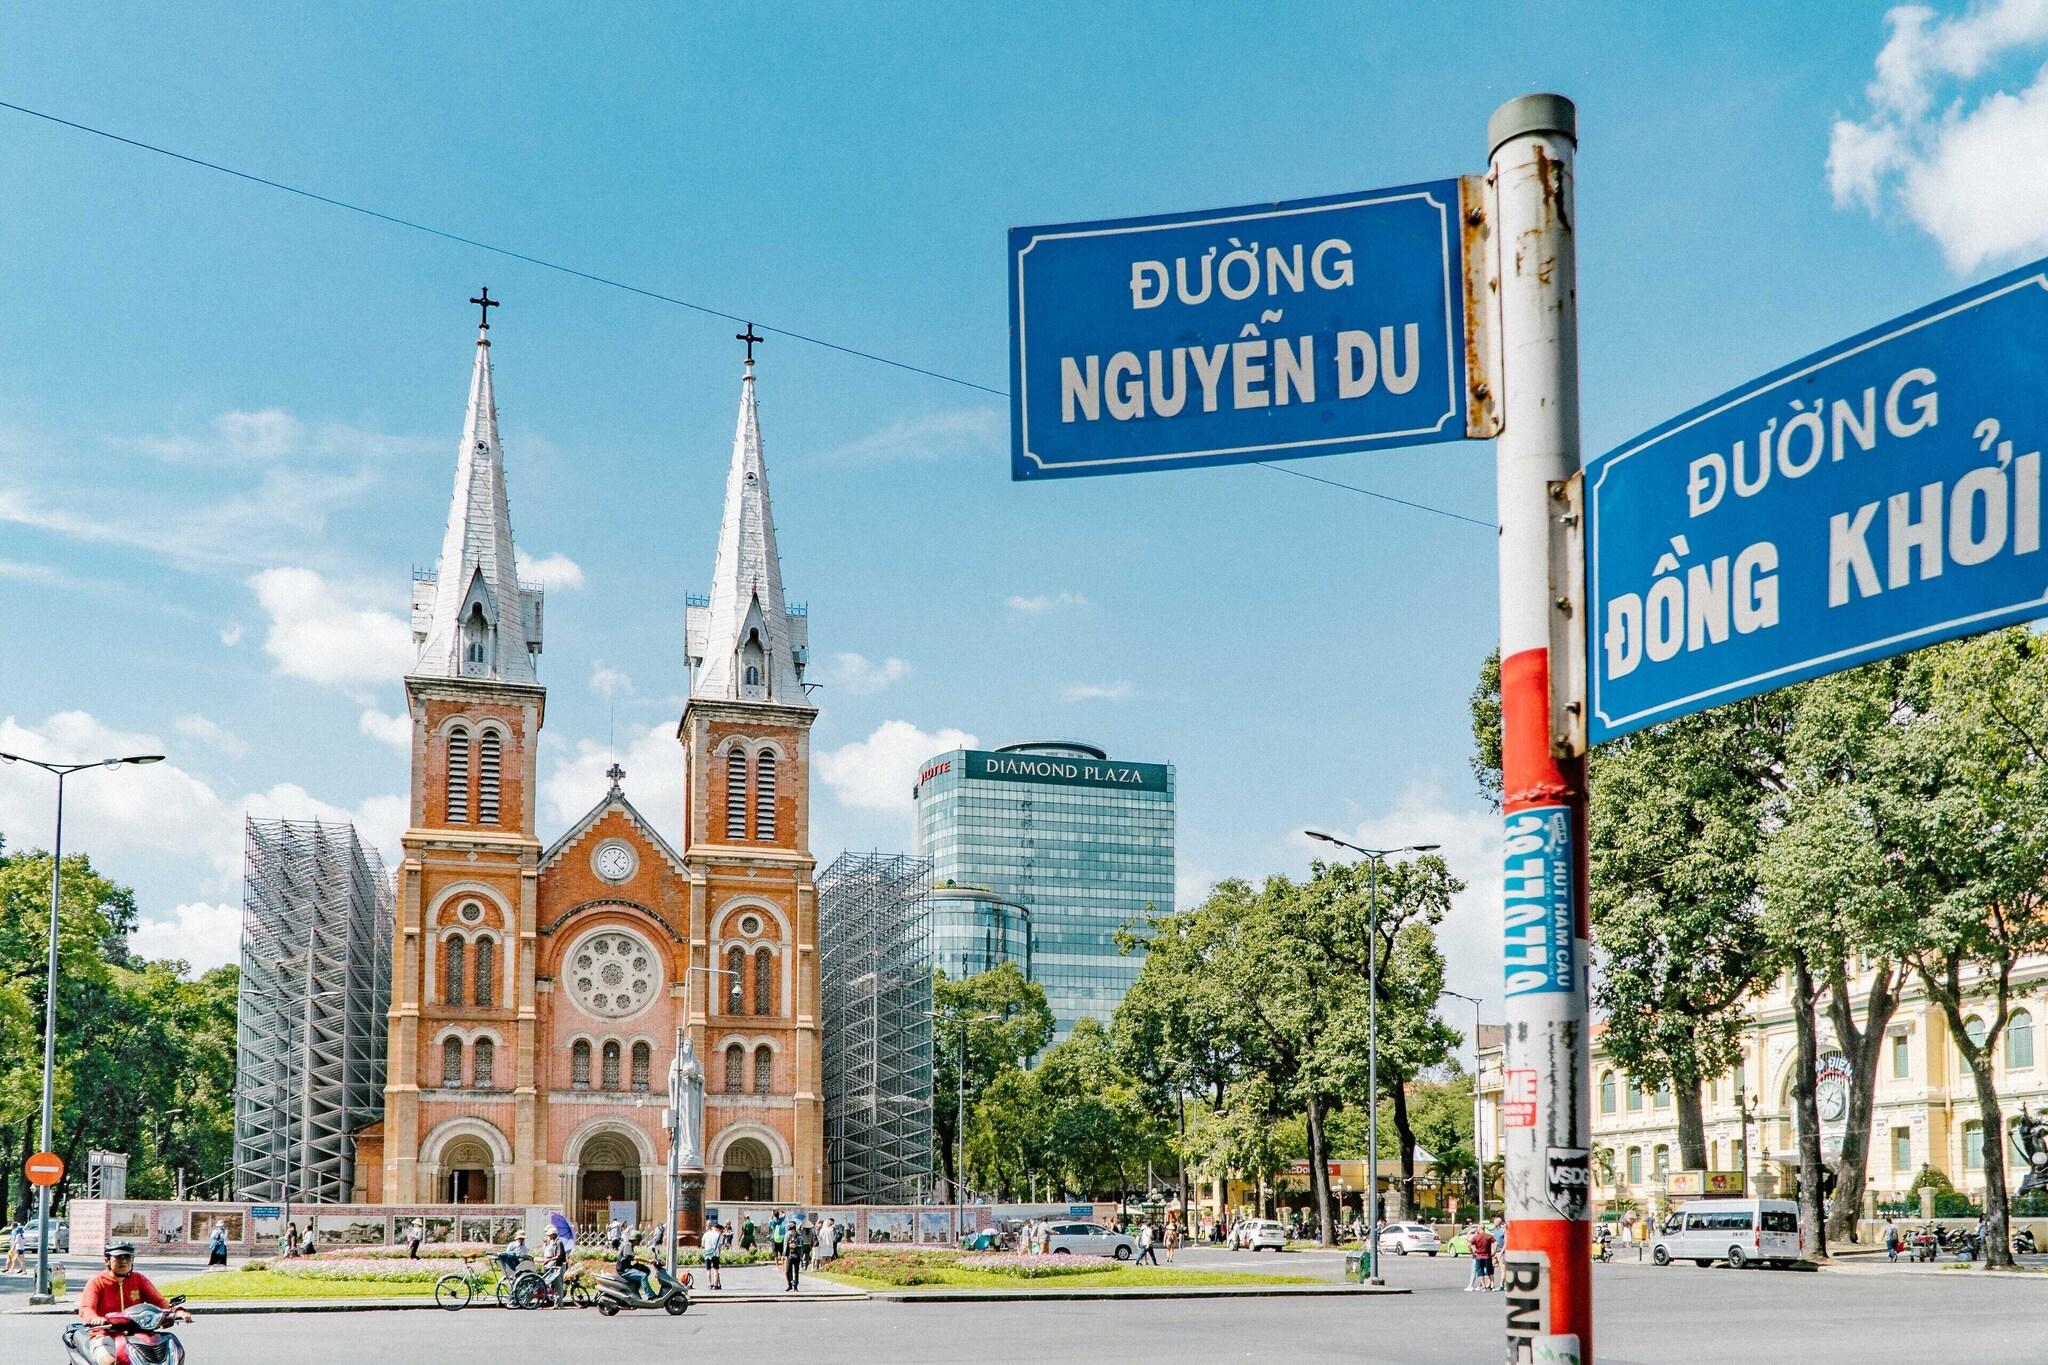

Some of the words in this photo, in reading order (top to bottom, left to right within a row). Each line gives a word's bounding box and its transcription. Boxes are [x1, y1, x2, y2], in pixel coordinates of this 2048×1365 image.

[1130, 237, 1354, 310] ĐƯỜNG
[1061, 309, 1316, 423] NGUYỄN
[1686, 367, 1938, 519] ĐƯỜNG
[1605, 534, 1779, 681] ĐỒNG
[1827, 417, 2041, 609] KHỞI
[987, 759, 1077, 779] DIAMOND
[1084, 766, 1143, 784] PLAZA
